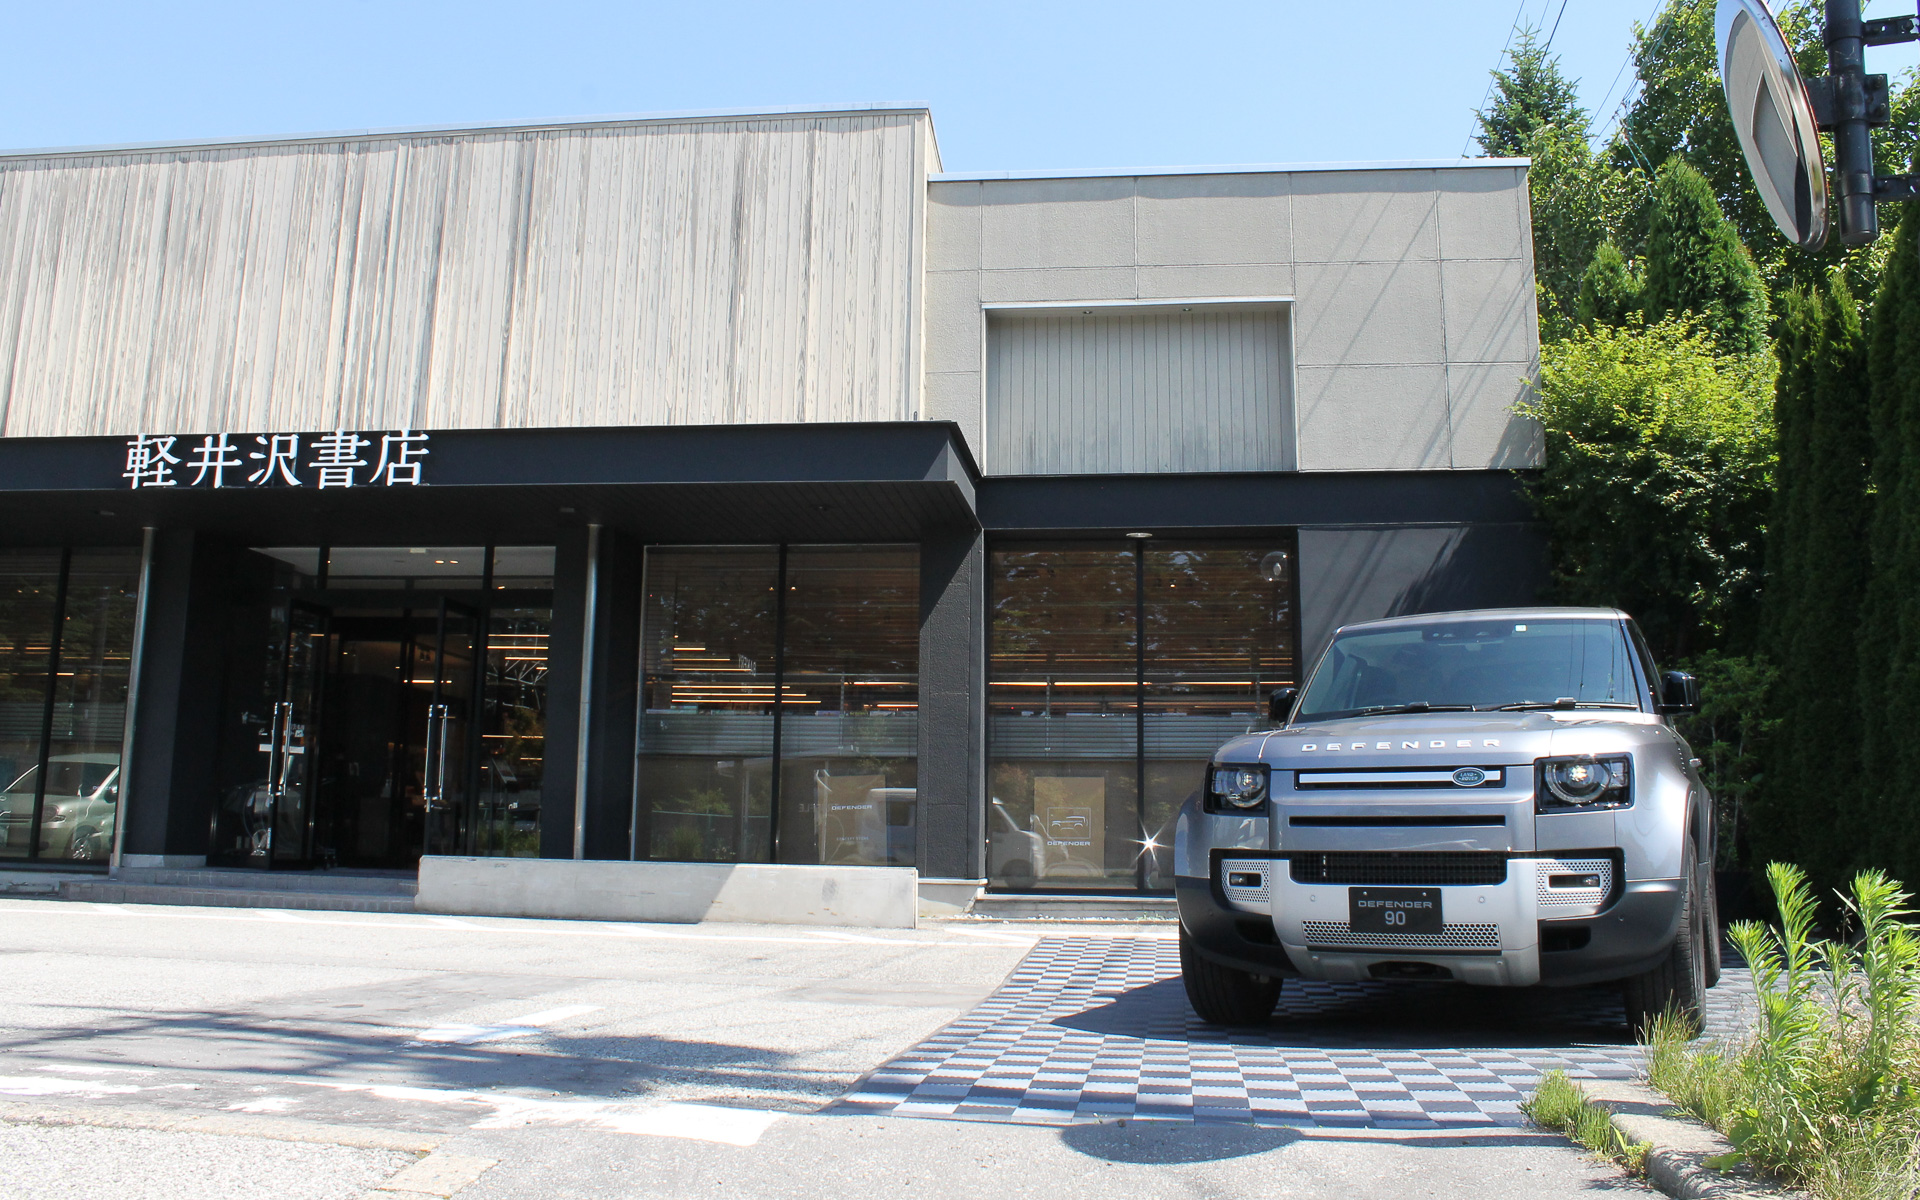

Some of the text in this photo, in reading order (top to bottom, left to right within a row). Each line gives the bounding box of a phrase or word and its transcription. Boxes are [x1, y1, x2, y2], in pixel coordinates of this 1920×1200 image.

[122, 428, 430, 490] 軽井沢書店
[1301, 738, 1501, 752] DEFENDER
[1358, 900, 1432, 908] DEFENDER
[1384, 910, 1406, 925] 90
